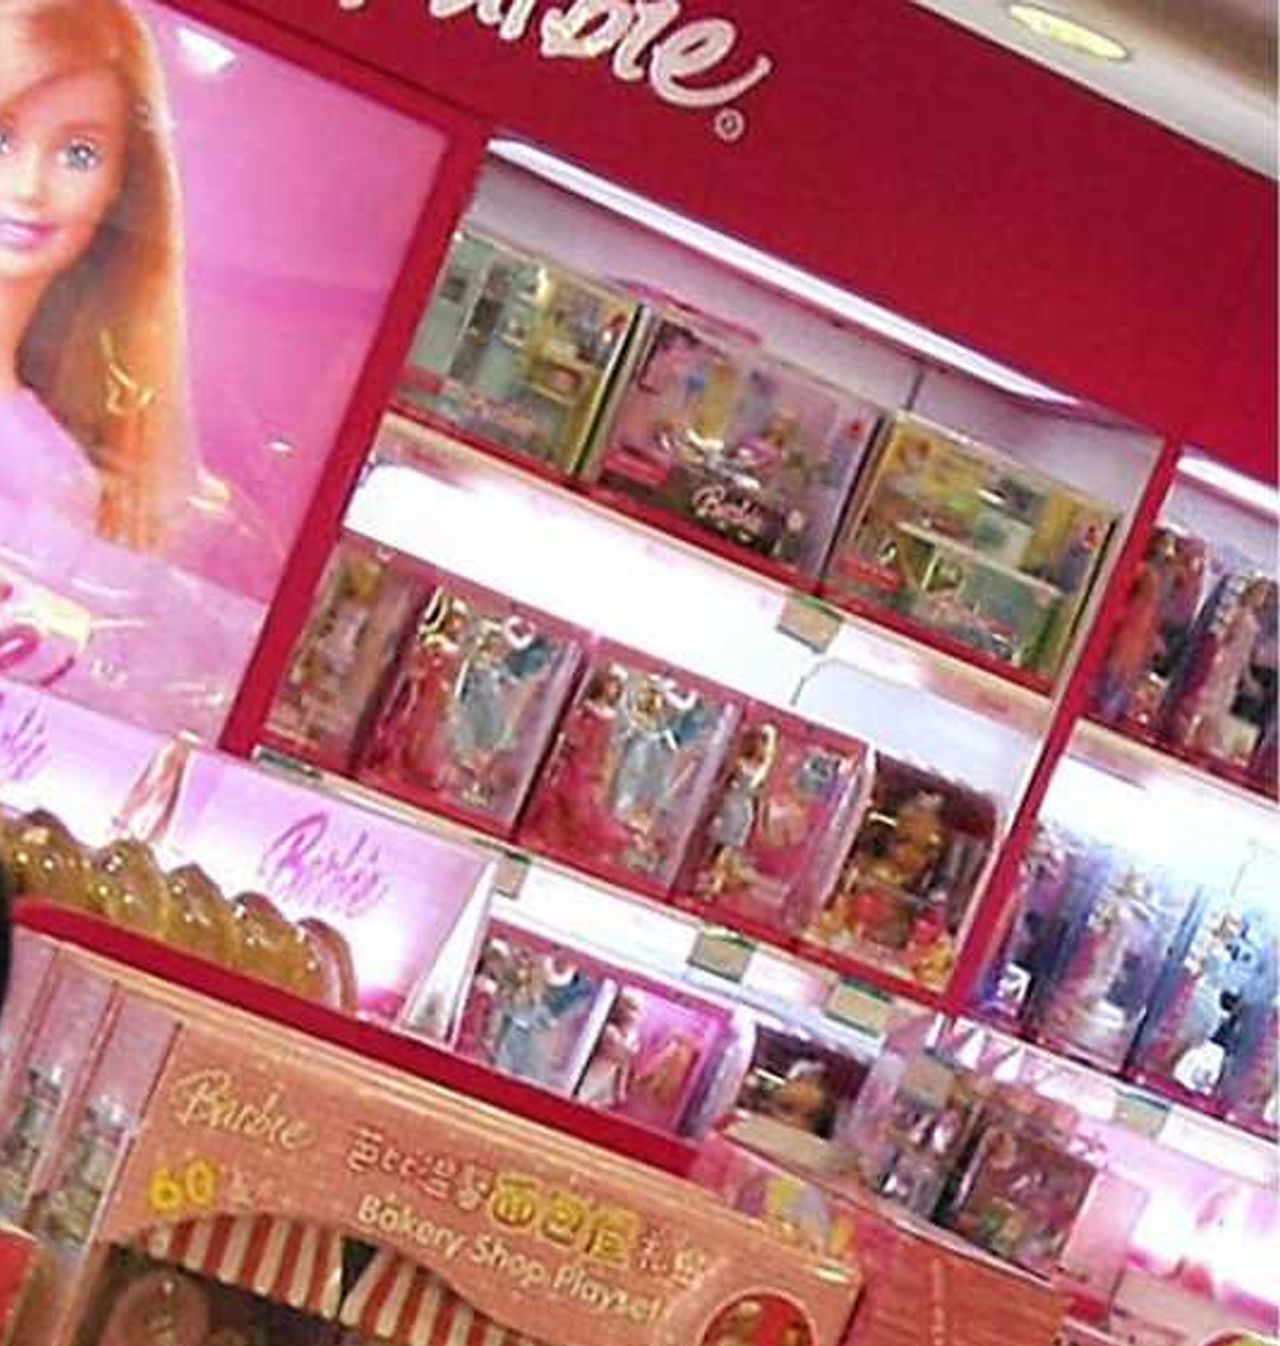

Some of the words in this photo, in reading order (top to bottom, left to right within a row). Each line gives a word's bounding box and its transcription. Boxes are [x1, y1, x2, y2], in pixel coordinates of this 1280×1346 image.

[175, 1069, 320, 1150] Barbie
[357, 1192, 466, 1260] Bakery
[471, 1233, 548, 1290] Shop
